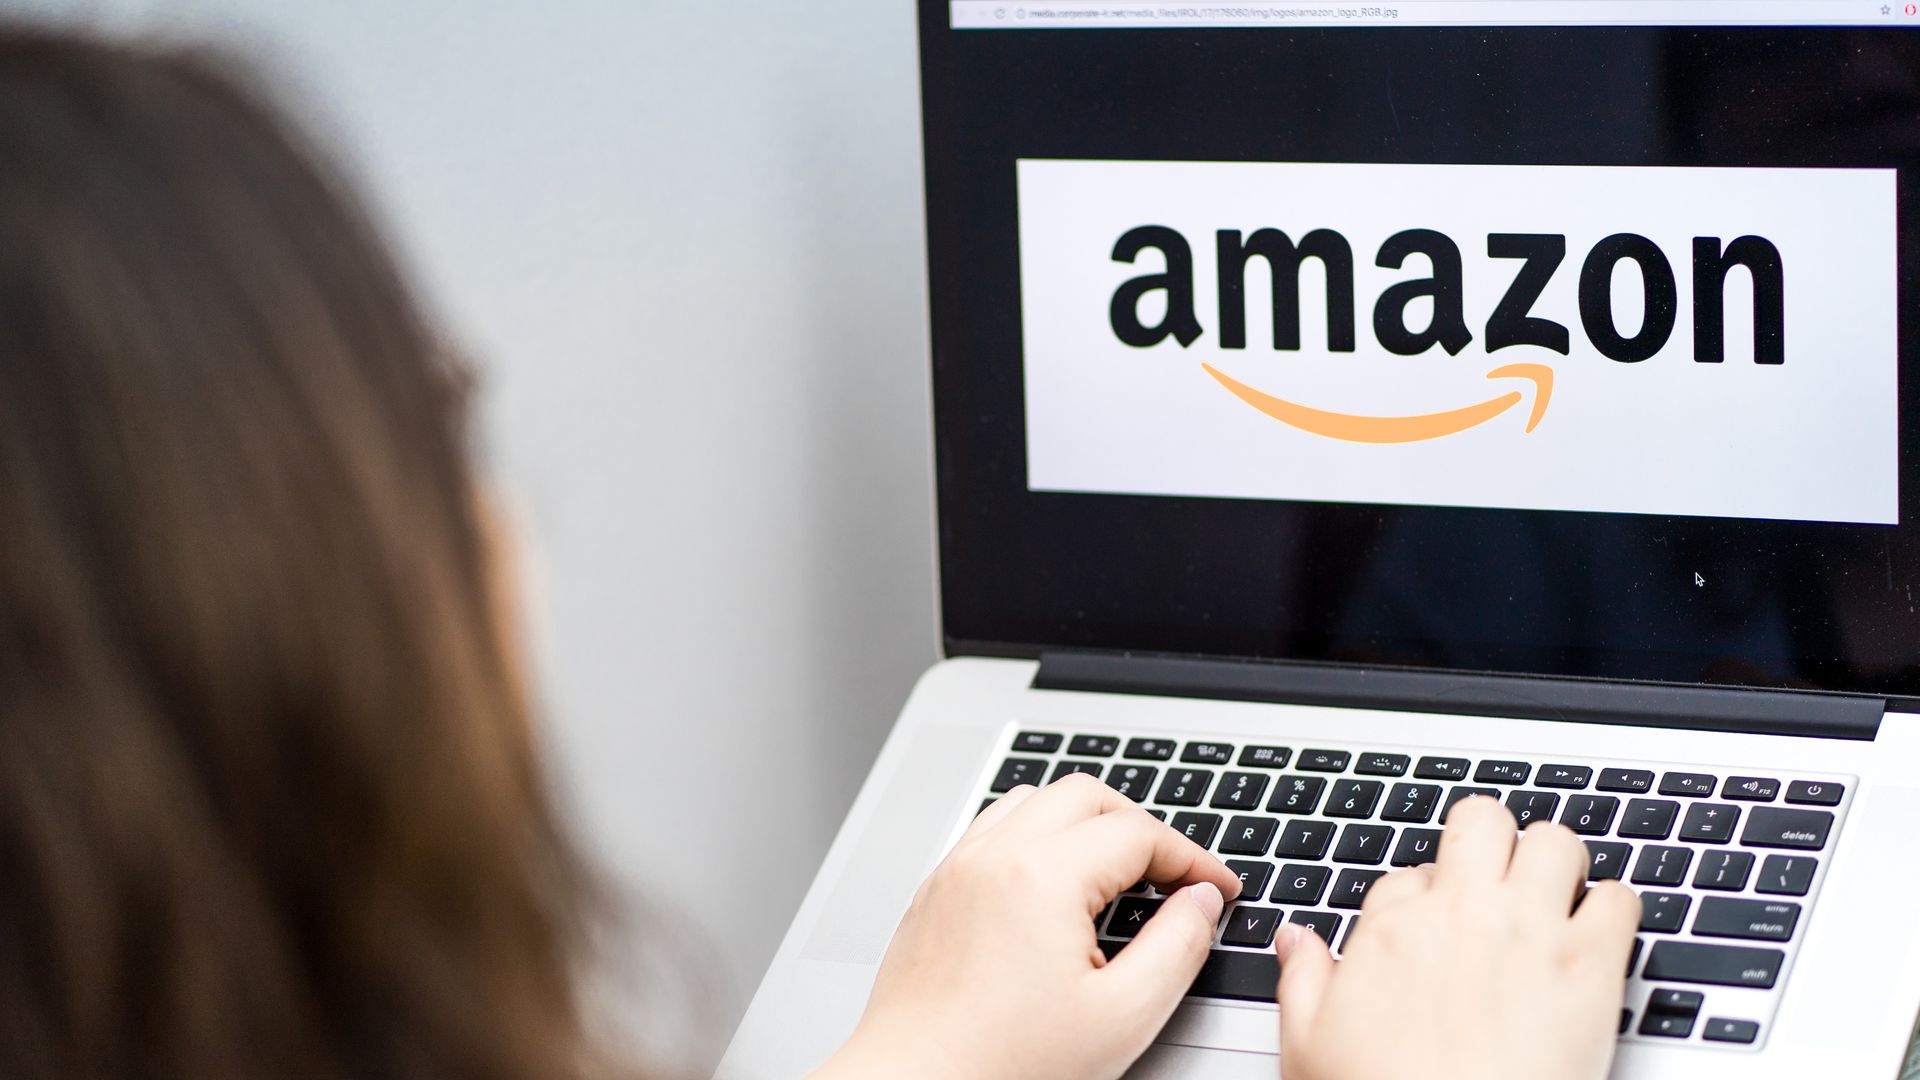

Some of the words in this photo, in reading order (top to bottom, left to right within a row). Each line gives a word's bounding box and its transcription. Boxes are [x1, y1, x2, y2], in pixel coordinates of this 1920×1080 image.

[1110, 224, 1786, 364] amazon
[1392, 764, 1403, 772] F6
[1451, 768, 1463, 777] F7
[1237, 775, 1248, 788] $
[1511, 772, 1523, 780] F8
[1573, 776, 1584, 784] F9
[1118, 781, 1131, 793] 2
[1293, 779, 1305, 791] %
[1632, 780, 1646, 788] F10
[1696, 784, 1710, 792] F11
[1173, 786, 1186, 798] 3
[1230, 790, 1242, 801] 4
[1407, 787, 1419, 799] &
[1757, 788, 1773, 796] F12
[1287, 794, 1299, 805] 5
[1345, 798, 1355, 809] 6
[1402, 801, 1414, 813] 7
[1520, 810, 1531, 821] 9
[1706, 809, 1718, 818] +
[1184, 823, 1197, 836] E
[1242, 827, 1255, 840] R
[1302, 831, 1312, 844] T
[1359, 835, 1370, 848] Y
[1781, 830, 1817, 842] delete
[1414, 840, 1429, 852] U
[1594, 852, 1608, 865] P
[1293, 877, 1308, 889] G
[1350, 881, 1366, 893] H
[1764, 905, 1790, 913] enter
[1128, 909, 1144, 922] X
[1247, 918, 1259, 931] V
[1748, 922, 1785, 933] return
[1741, 969, 1768, 980] shift
